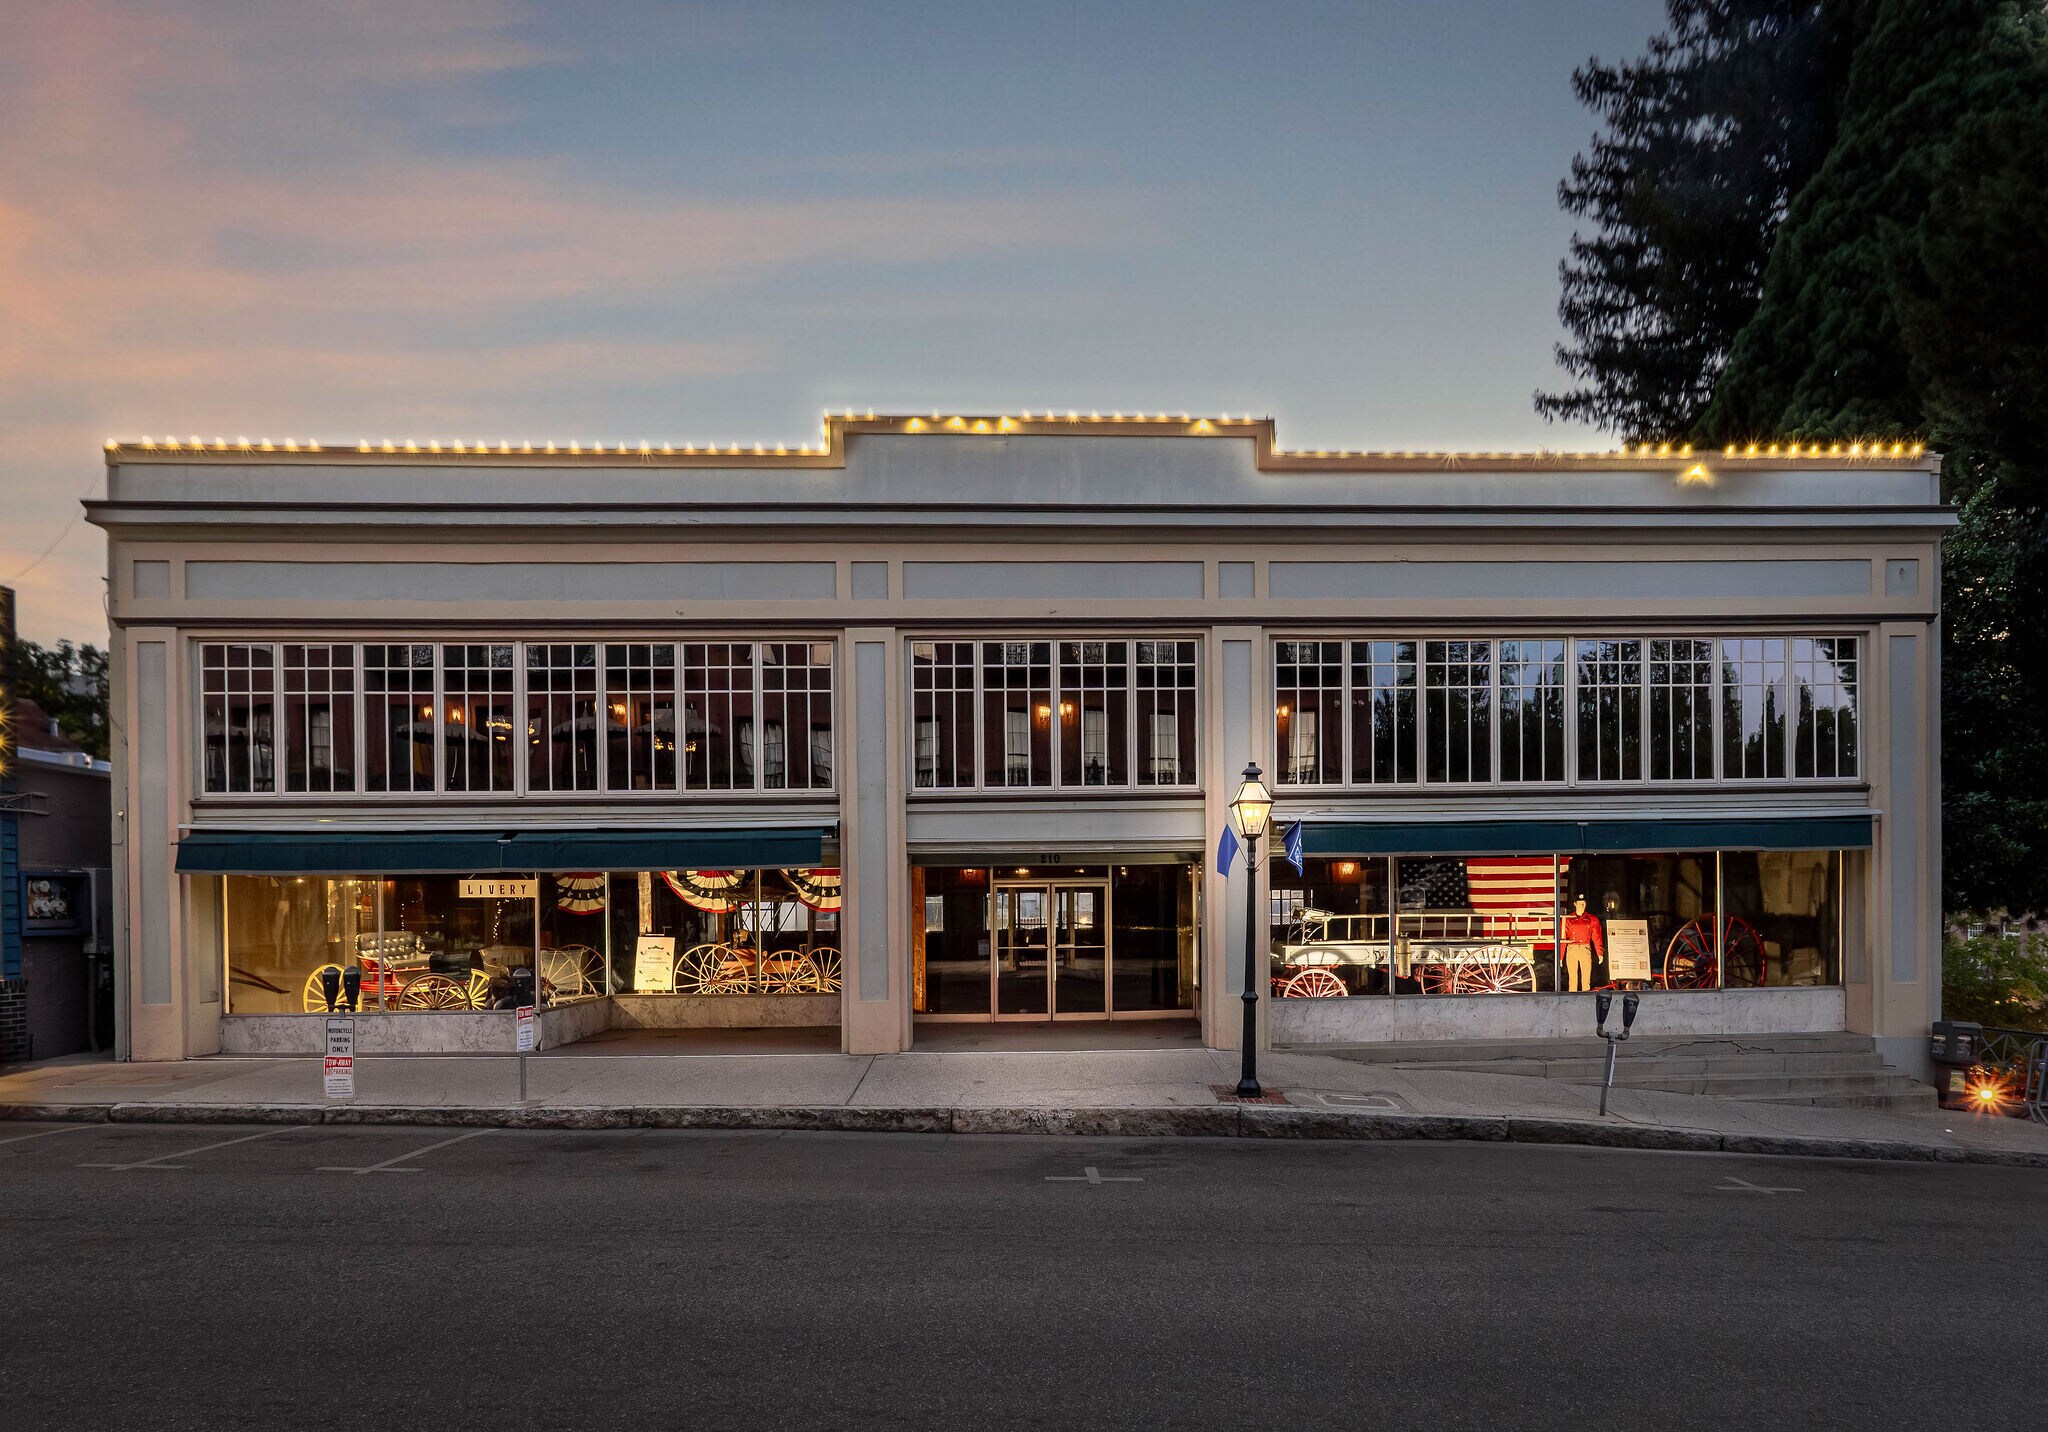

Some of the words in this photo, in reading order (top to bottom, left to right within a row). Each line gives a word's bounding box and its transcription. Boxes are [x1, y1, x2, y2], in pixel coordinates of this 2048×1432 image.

[1040, 854, 1060, 864] 210
[467, 884, 527, 895] LIVERY
[326, 1059, 352, 1067] TOW-AWAY
